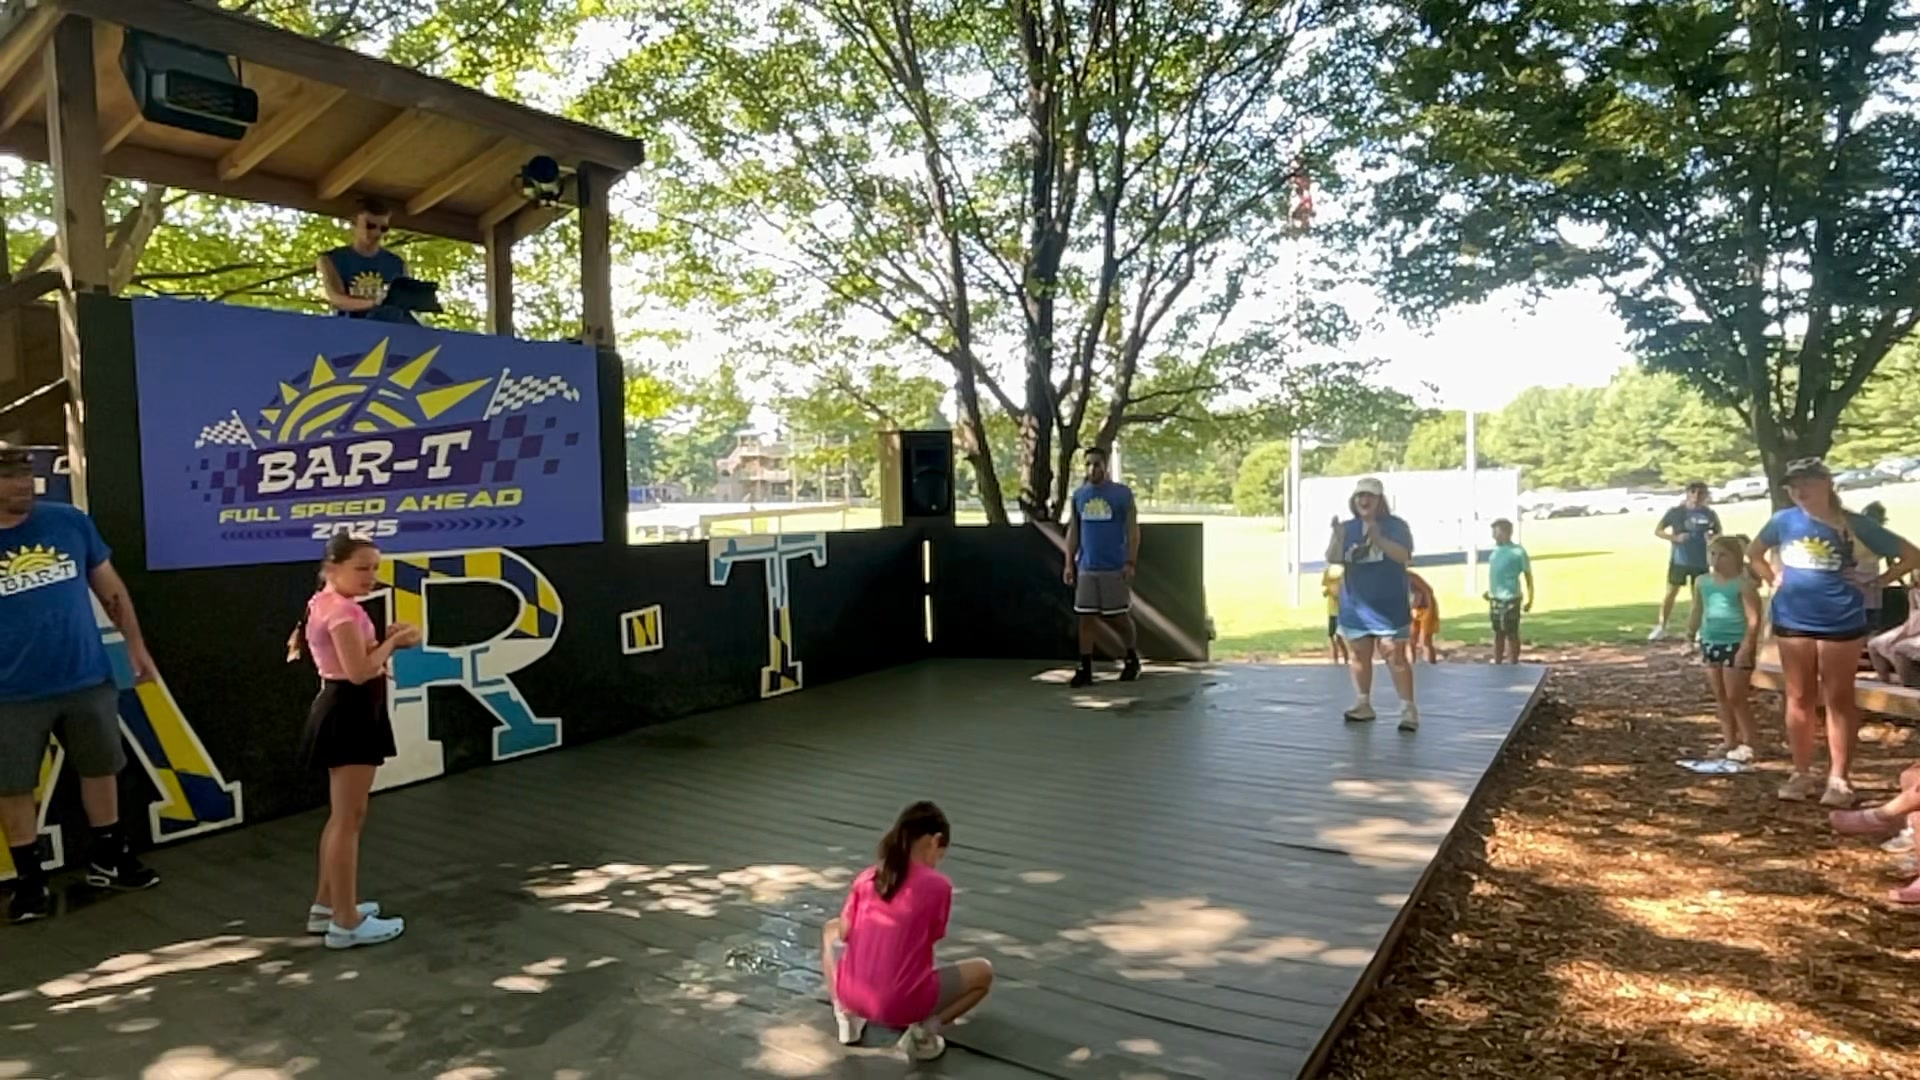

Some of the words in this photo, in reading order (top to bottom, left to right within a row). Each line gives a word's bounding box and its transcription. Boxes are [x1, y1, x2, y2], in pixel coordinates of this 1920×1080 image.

[257, 430, 472, 494] BAR-T
[219, 507, 281, 524] FULL
[290, 498, 386, 519] SPEED
[396, 488, 524, 512] AHEAD
[312, 519, 399, 540] 2025
[2, 563, 73, 592] BAR-T
